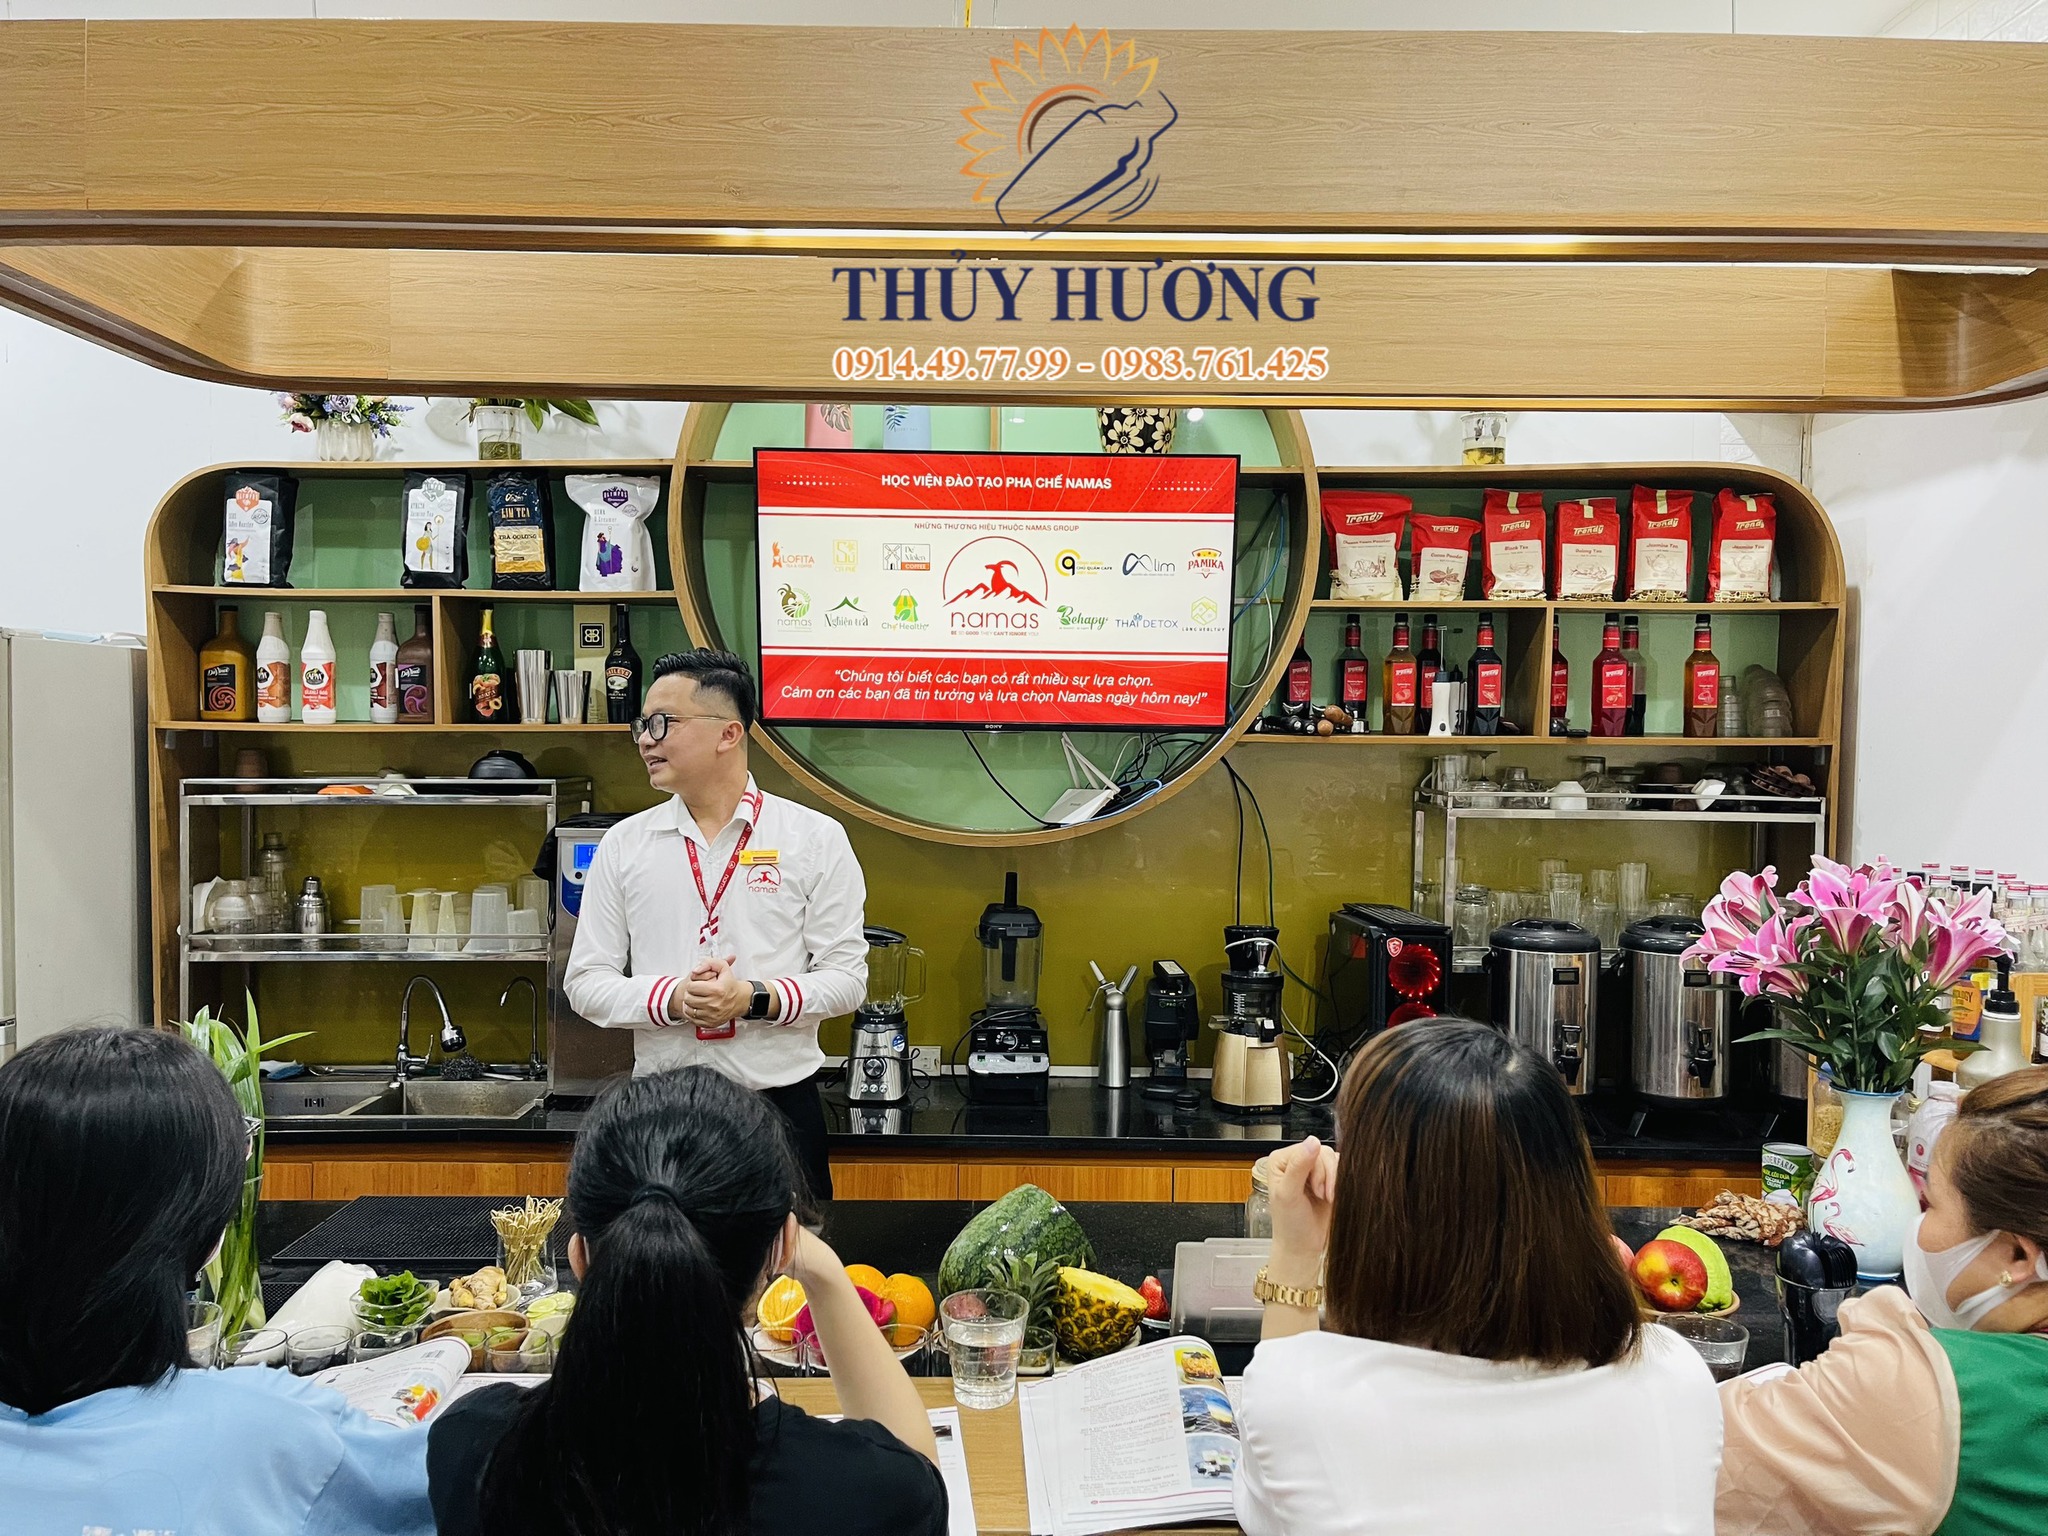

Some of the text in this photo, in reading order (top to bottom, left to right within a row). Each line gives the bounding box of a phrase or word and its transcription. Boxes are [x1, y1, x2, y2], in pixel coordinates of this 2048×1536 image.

[882, 474, 1112, 489] HỌC VIỆN ĐÀO TẠO PHA CHẾ NAMAS
[1346, 512, 1384, 525] Trendy
[1648, 518, 1679, 529] Trendy
[1432, 525, 1459, 533] Trendy
[1501, 520, 1530, 533] Trendy
[1574, 525, 1604, 536] Trendy
[783, 555, 815, 564] LOFITA
[1188, 559, 1224, 571] PAMIKA
[777, 618, 812, 626] namas
[951, 612, 1039, 629] namas
[1143, 620, 1178, 628] DETOX
[887, 671, 903, 682] tôi
[907, 670, 932, 683] biết
[935, 672, 959, 683] các
[962, 672, 987, 686] bạn
[991, 672, 1007, 684] có
[1011, 671, 1029, 685] rất
[1033, 672, 1068, 685] nhiều
[1072, 674, 1090, 687] sự
[1093, 673, 1114, 687] lựa
[1118, 674, 1153, 688] chọn.
[816, 688, 834, 699] ơn
[838, 688, 862, 699] các
[865, 688, 890, 701] bạn
[894, 688, 910, 699] đã
[914, 689, 930, 700] tin
[979, 688, 993, 701] và
[997, 690, 1018, 703] lựa
[1022, 691, 1054, 705] chọn
[1057, 691, 1102, 703] Namas
[1106, 692, 1138, 707] ngày
[1141, 692, 1170, 704] hôm
[718, 874, 729, 894] namas
